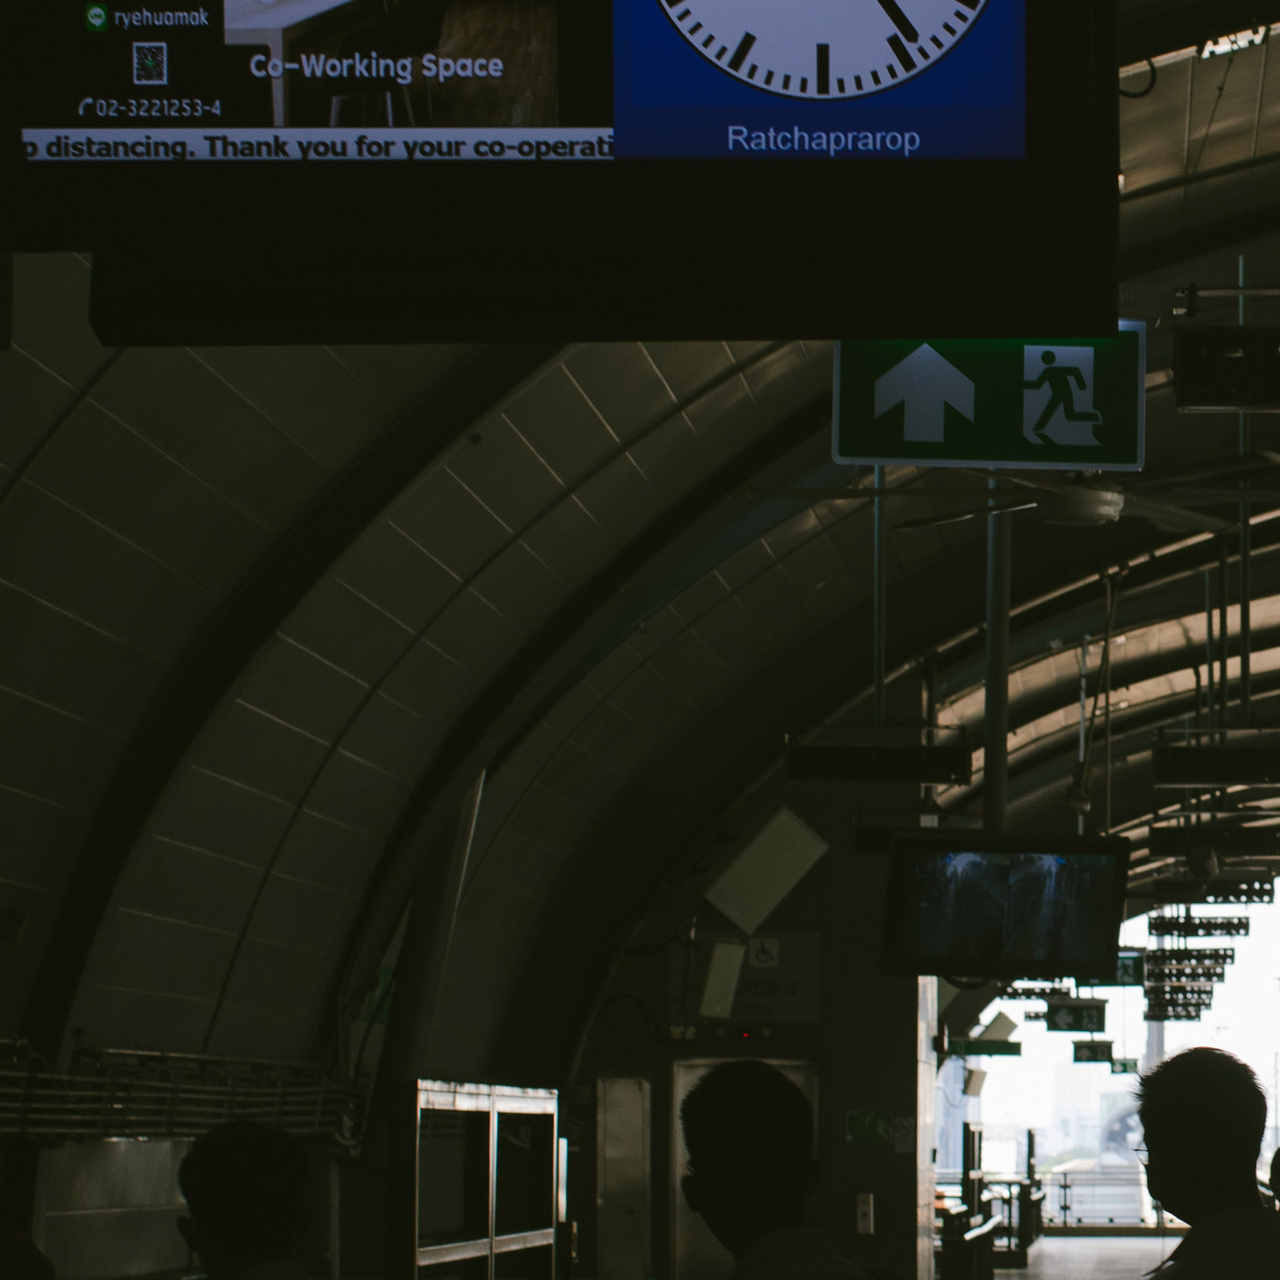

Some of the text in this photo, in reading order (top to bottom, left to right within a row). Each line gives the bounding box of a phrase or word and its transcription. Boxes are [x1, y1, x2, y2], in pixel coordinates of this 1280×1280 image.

[114, 7, 209, 30] ryehuamak
[249, 52, 504, 84] Co-Working Space
[95, 98, 222, 117] 02-3221253-4
[46, 135, 196, 160] distancing.
[204, 135, 289, 158] Thank
[297, 140, 348, 160] you
[355, 134, 396, 158] for
[402, 140, 467, 160] your
[473, 135, 614, 160] co-operati
[727, 124, 922, 156] Ratchaprarop
